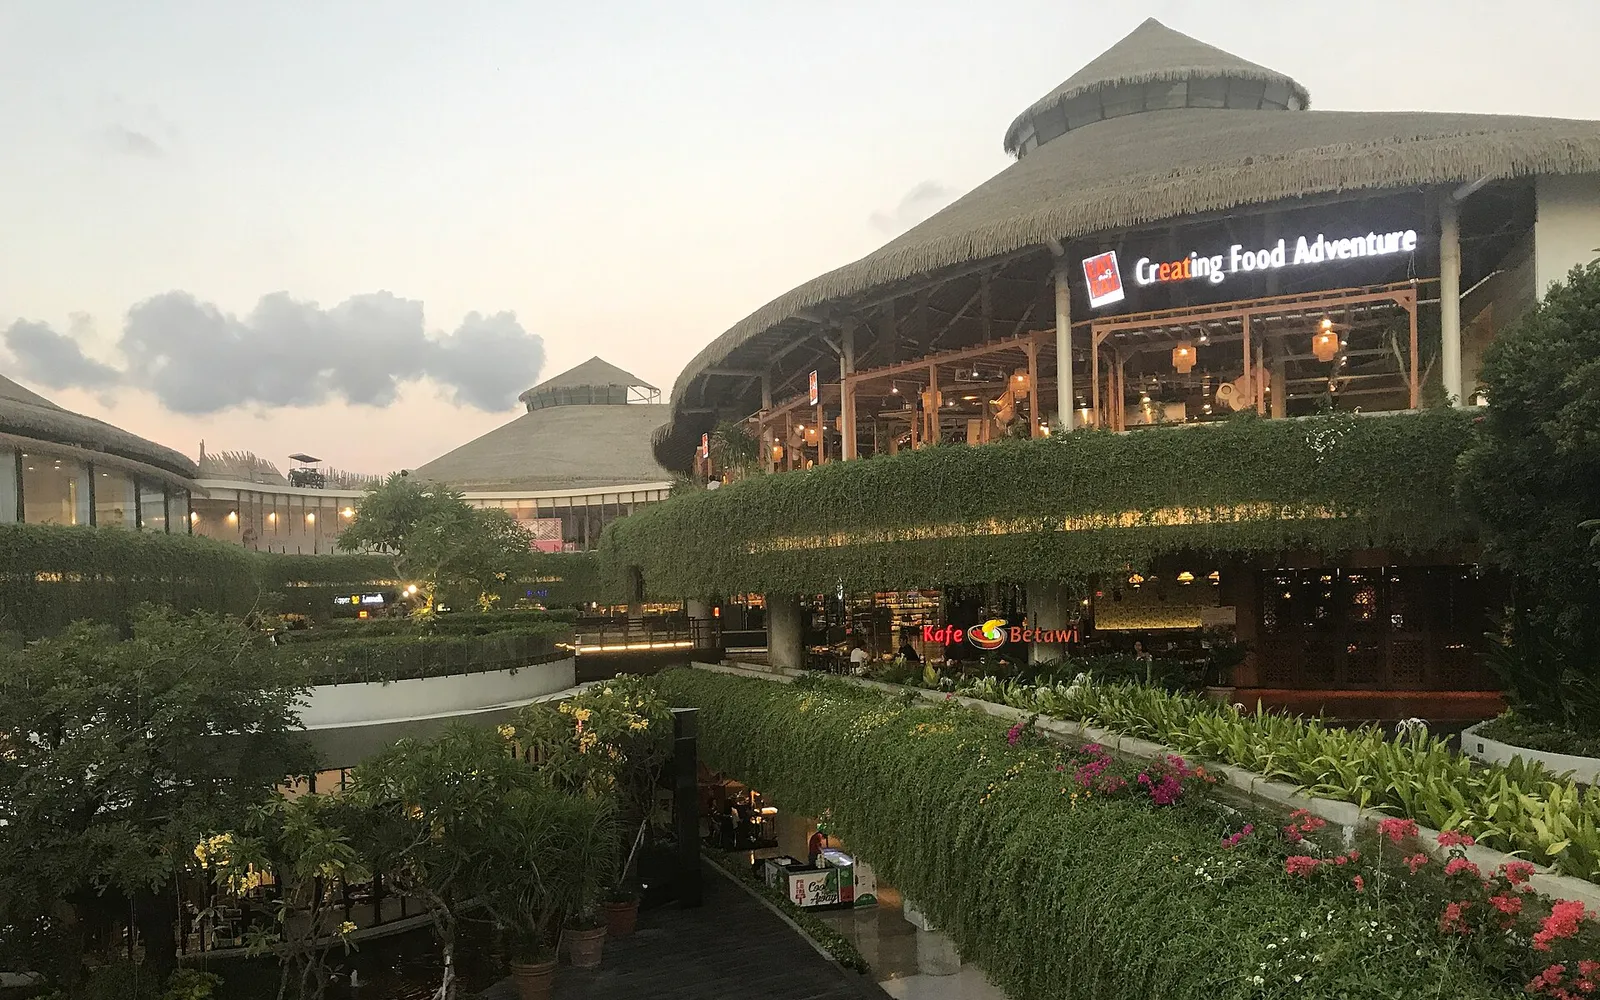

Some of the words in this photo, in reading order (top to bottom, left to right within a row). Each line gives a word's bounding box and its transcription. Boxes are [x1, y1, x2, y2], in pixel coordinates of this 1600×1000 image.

[1135, 251, 1225, 285] Creating
[1230, 239, 1285, 273] Food
[1293, 229, 1417, 265] Adventure
[923, 624, 963, 646] Kafe
[1010, 626, 1080, 643] Betawi
